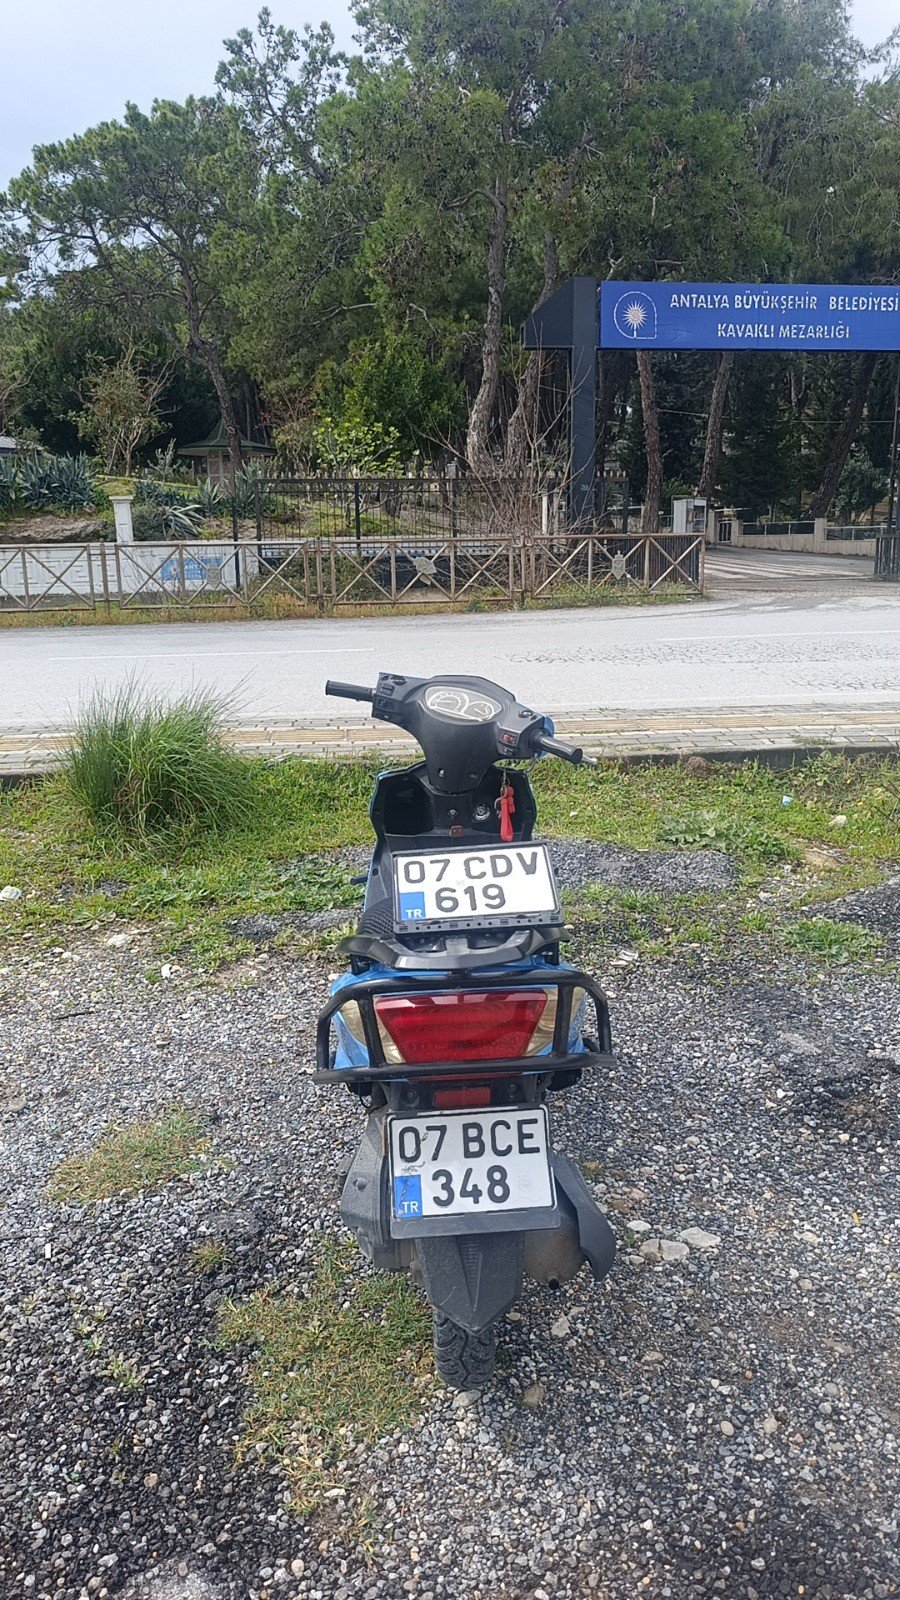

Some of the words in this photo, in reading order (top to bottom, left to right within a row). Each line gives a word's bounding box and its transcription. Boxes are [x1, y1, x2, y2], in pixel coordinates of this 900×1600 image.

[670, 293, 730, 309] ANTALYA
[734, 290, 818, 314] BÜYÜKŞEHİR
[829, 292, 899, 311] BELEDİYESİ
[717, 323, 775, 338] KAVAKLI
[778, 320, 850, 339] MEZARLIĞI
[404, 860, 451, 884] 07
[463, 851, 538, 880] CDV
[434, 883, 507, 912] 619
[405, 909, 423, 918] TR
[398, 1124, 447, 1163] 07
[462, 1118, 541, 1158] BCE
[431, 1165, 511, 1207] 348
[402, 1201, 419, 1213] TR
